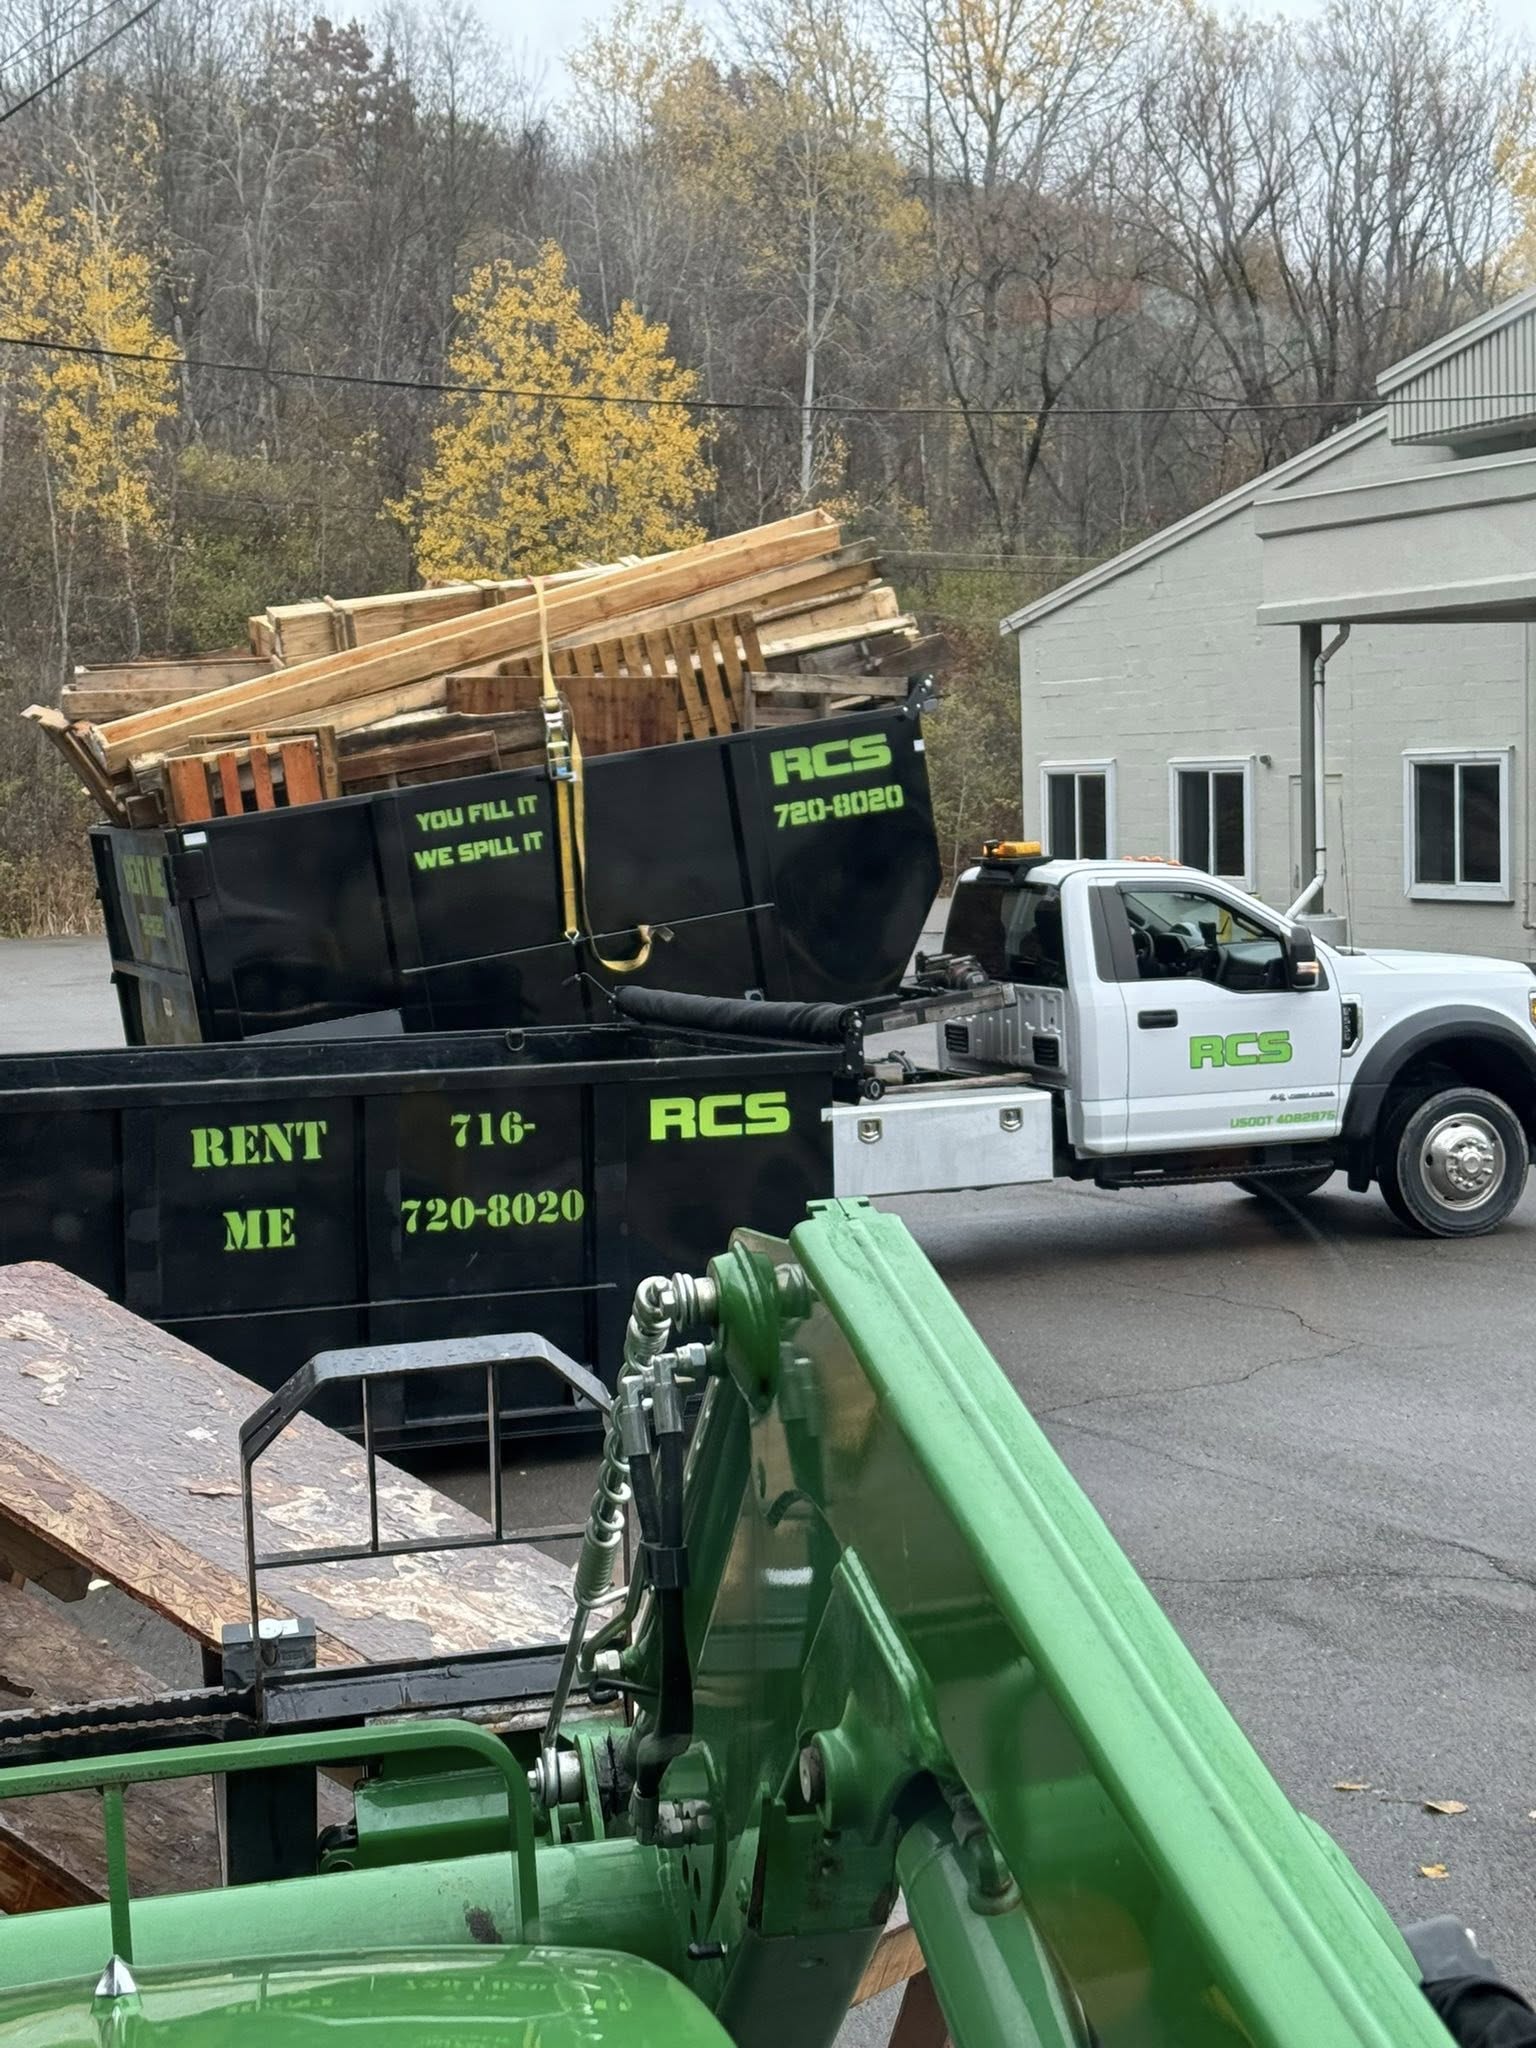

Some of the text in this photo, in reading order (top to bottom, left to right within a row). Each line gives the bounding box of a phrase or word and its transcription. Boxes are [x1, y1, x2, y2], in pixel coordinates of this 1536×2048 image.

[770, 733, 892, 785] RCS
[416, 795, 538, 832] YOU FILL IT
[773, 784, 905, 828] 720-8020
[414, 831, 543, 870] WE SPILL IT
[1189, 1030, 1293, 1069] RCS
[450, 1111, 535, 1148] 716-
[650, 1091, 791, 1140] RCS
[1230, 1115, 1273, 1129] USDOT
[190, 1121, 328, 1169] RENT
[223, 1208, 296, 1251] ME
[401, 1189, 585, 1234] 720-8020
